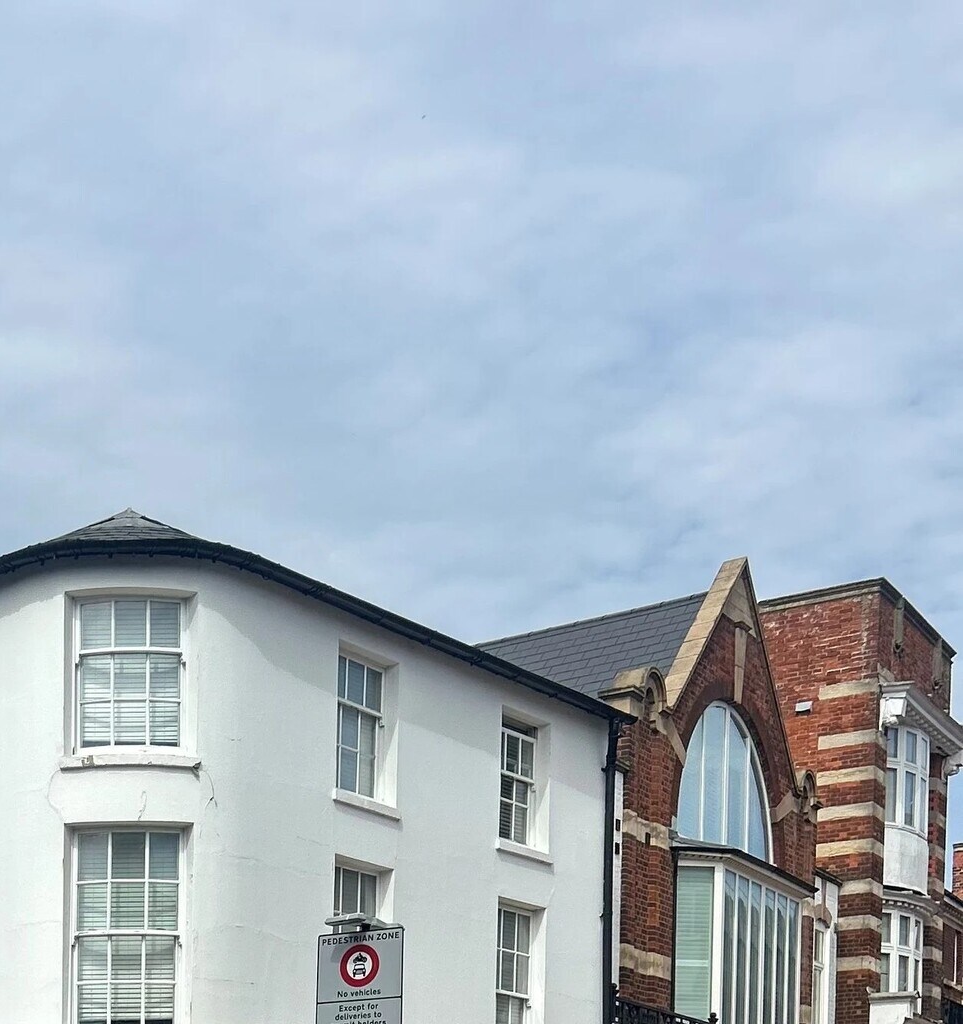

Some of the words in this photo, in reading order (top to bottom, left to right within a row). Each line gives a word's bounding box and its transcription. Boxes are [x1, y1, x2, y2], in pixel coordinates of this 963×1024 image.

[322, 934, 374, 946] PEDESTRIAN
[376, 931, 400, 941] ZONE
[337, 990, 348, 998] No
[350, 988, 381, 997] vehicles
[338, 1004, 365, 1013] Except
[367, 1003, 379, 1011] for
[335, 1012, 371, 1021] deliveries
